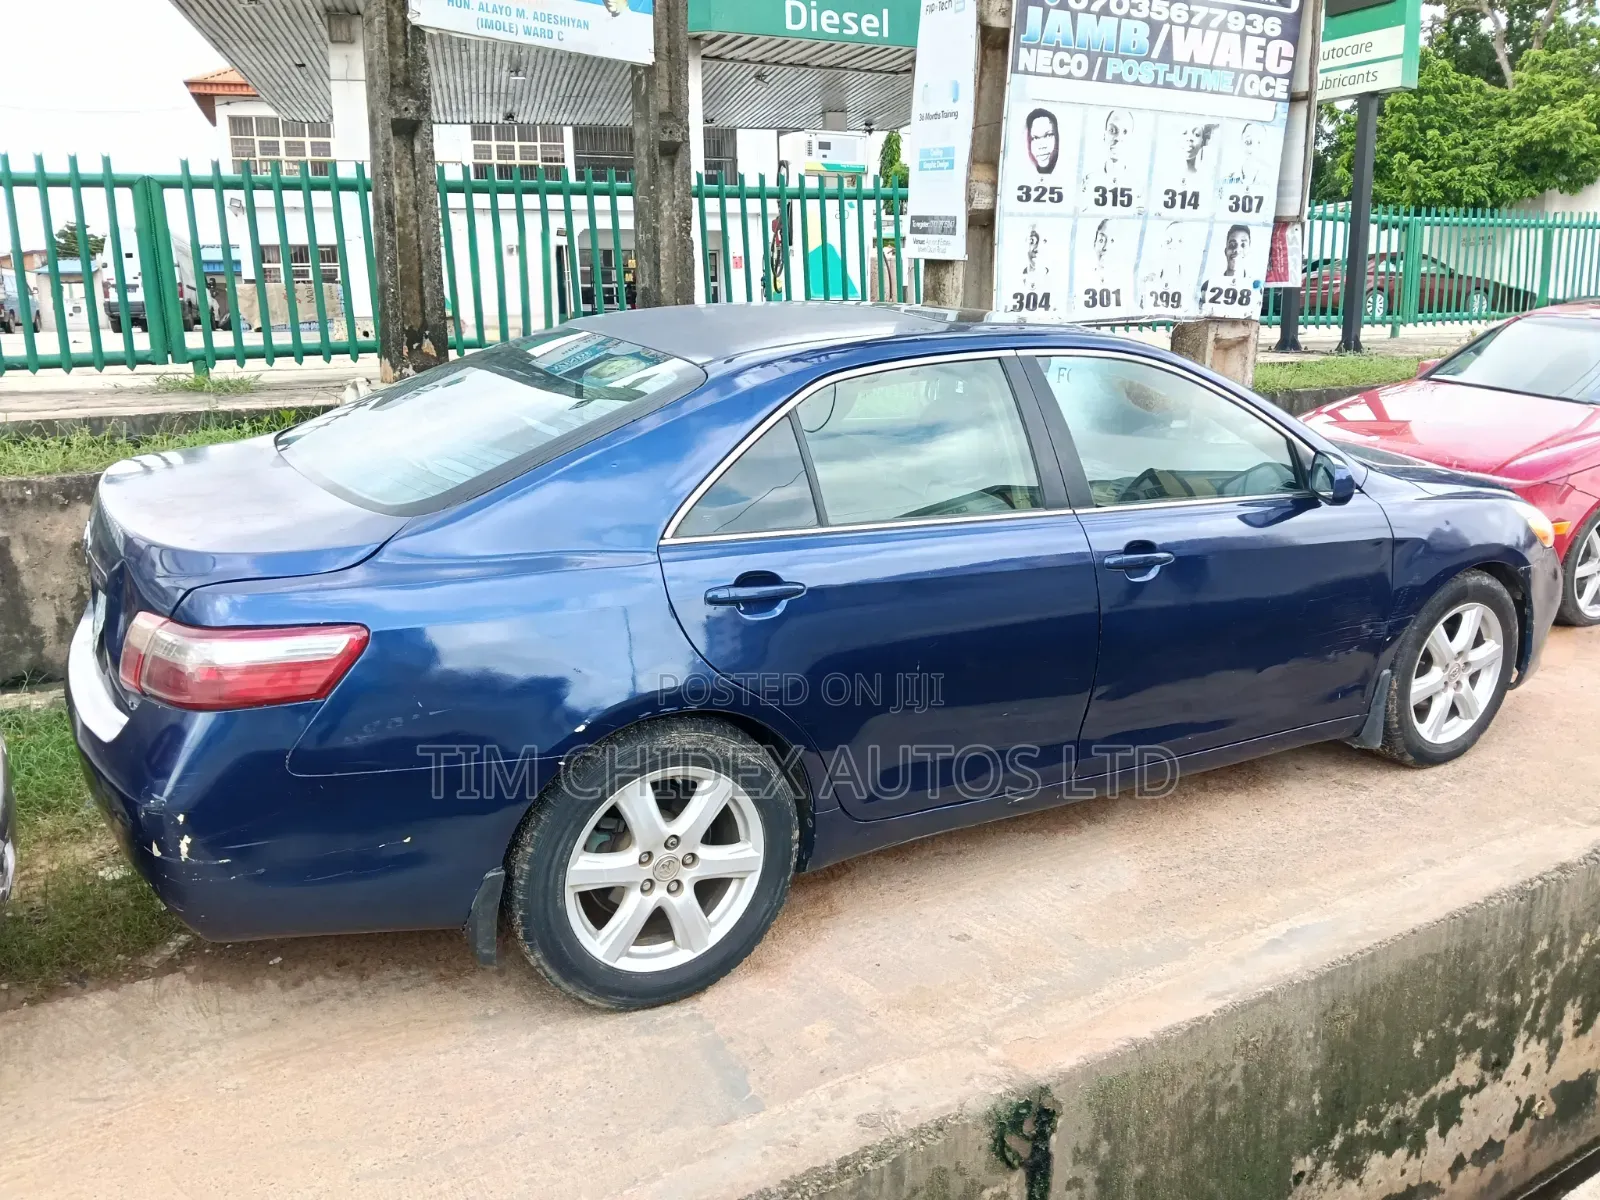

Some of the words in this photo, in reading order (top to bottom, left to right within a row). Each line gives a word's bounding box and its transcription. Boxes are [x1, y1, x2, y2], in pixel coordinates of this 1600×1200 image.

[478, 3, 512, 17] ALAYO
[516, 8, 529, 20] M.
[533, 11, 590, 31] ADESHIYAN
[785, 0, 889, 38] Diesel
[476, 17, 519, 35] (IMOLE)
[523, 25, 554, 40] WARD
[557, 32, 564, 41] C
[1320, 41, 1373, 61] utocare
[1018, 48, 1089, 78] NECO
[1318, 70, 1379, 91] ubricants
[1016, 185, 1064, 204] 325
[1093, 186, 1133, 208] 315
[1163, 188, 1200, 210] 314
[1228, 195, 1264, 214] 307
[1012, 292, 1051, 312] 304
[1084, 288, 1122, 308] 301
[1150, 290, 1182, 309] 299
[1209, 287, 1251, 306] 298
